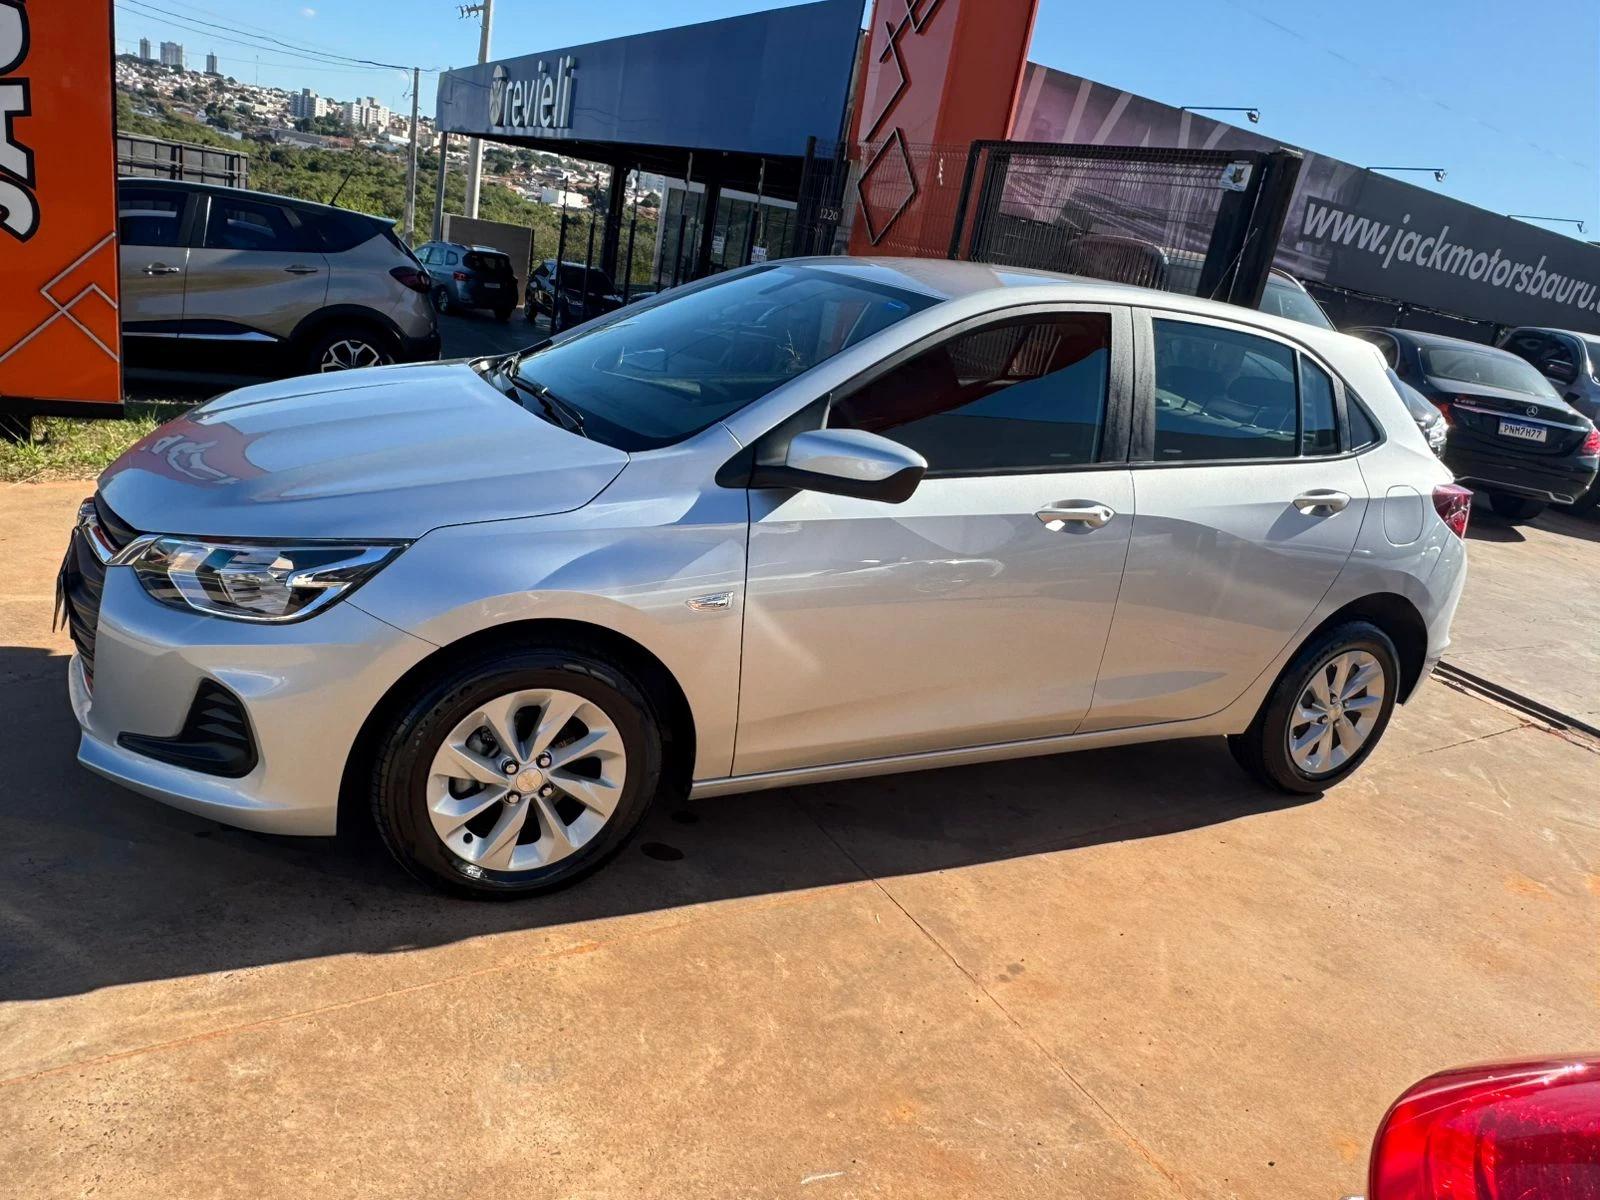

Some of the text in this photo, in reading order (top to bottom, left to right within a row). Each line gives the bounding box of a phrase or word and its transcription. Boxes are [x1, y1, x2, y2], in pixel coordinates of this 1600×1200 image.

[819, 207, 839, 221] 1220
[1302, 202, 1600, 314] www.jackmotorsbauru.
[1503, 423, 1543, 440] PNM7H77
